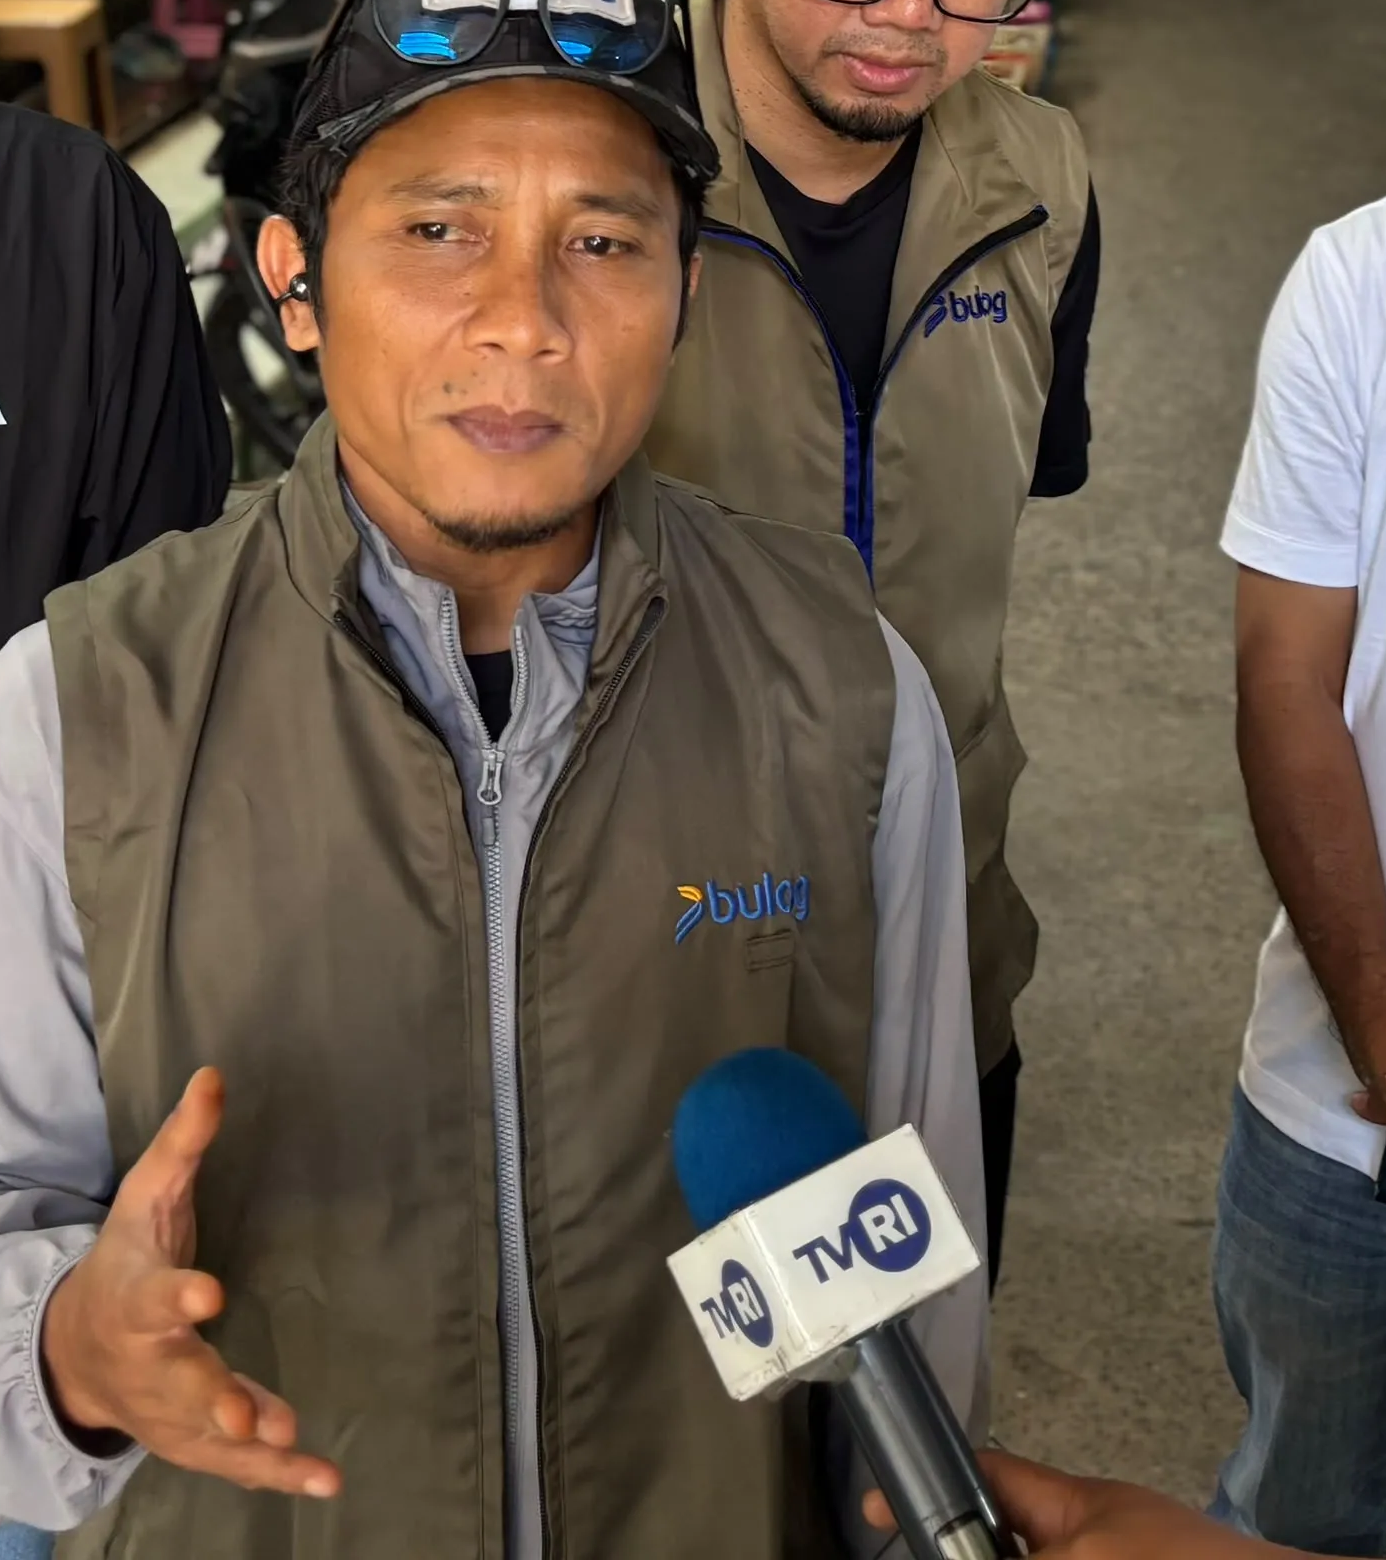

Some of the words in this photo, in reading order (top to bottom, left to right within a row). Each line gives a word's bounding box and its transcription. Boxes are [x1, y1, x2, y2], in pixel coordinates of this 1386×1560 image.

[706, 872, 810, 924] bulog
[793, 1192, 919, 1285] TVRI
[700, 1275, 763, 1340] TVRI
